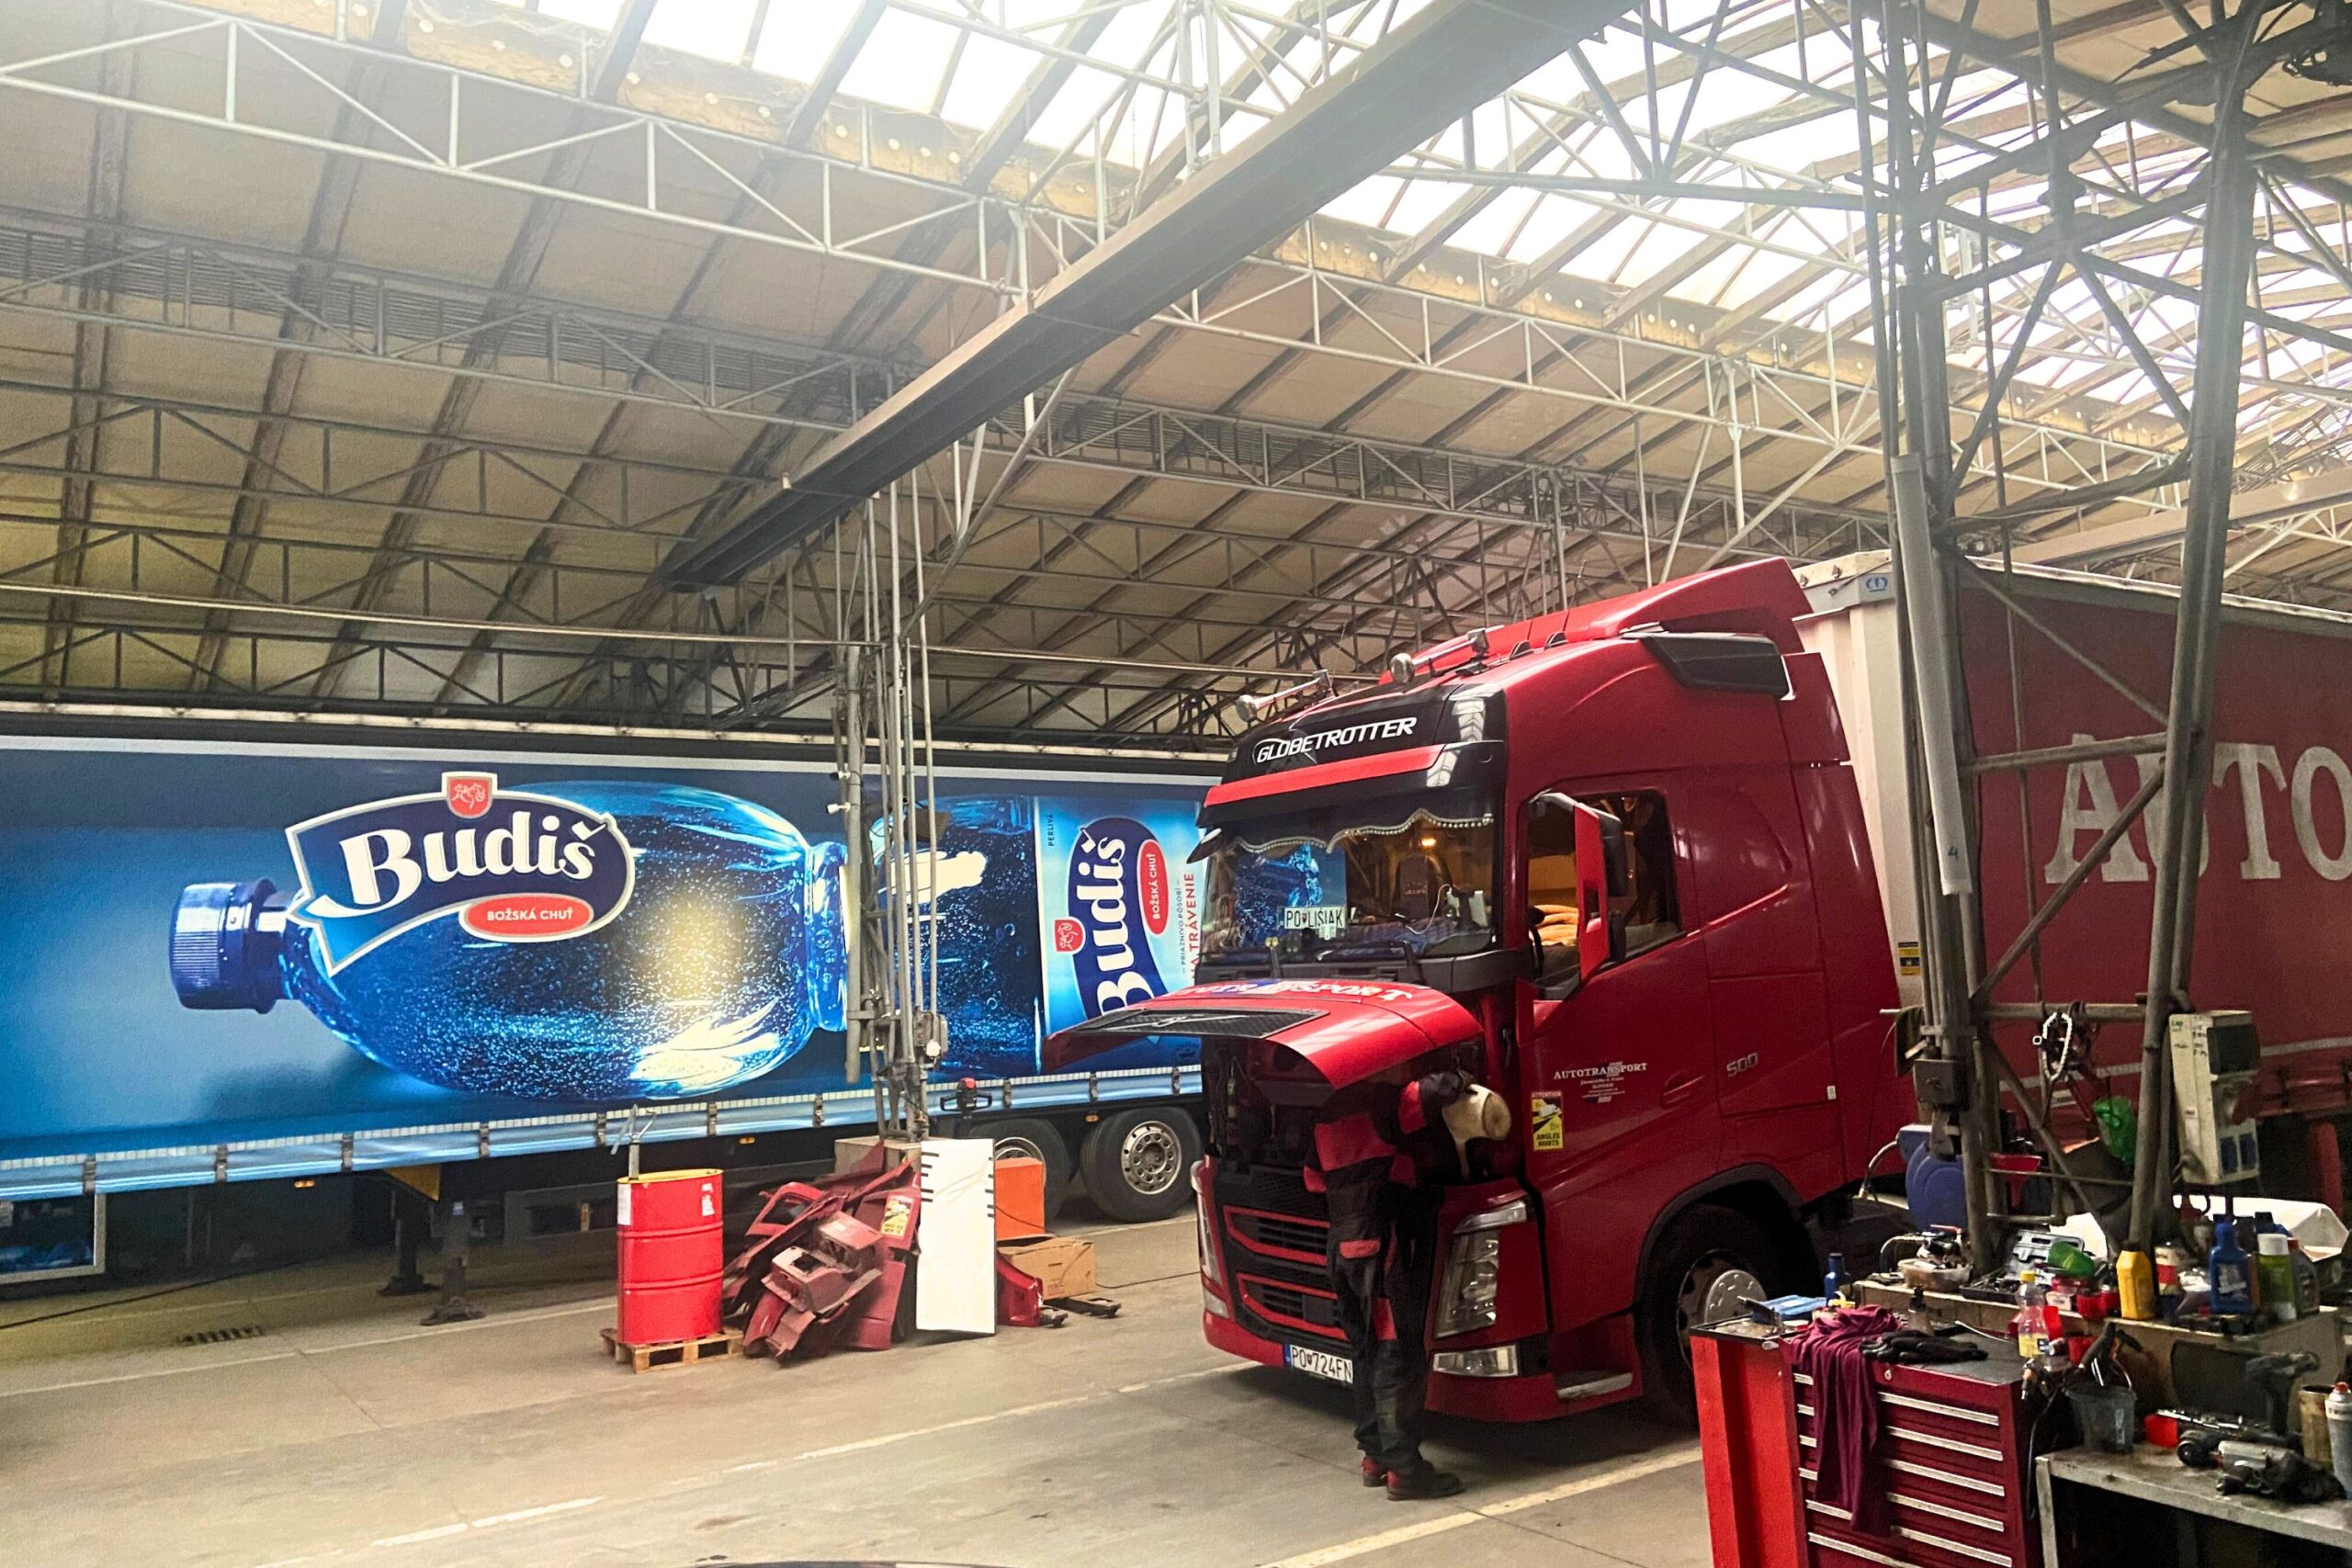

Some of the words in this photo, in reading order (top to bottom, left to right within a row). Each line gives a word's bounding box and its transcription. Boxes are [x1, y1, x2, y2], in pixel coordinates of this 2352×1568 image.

[1256, 716, 1417, 763] GLOBETROTTER
[306, 811, 606, 917] Budiš
[1146, 853, 1157, 878] CHUŤ
[487, 908, 537, 921] BOŽSKÁ
[539, 907, 573, 920] CHUŤ
[1148, 881, 1161, 919] BOŽSKÁ
[1184, 874, 1200, 952] TRÁVENIE
[1076, 829, 1155, 1015] Budiš
[1554, 1063, 1647, 1079] AUTOTRANSPORT
[1726, 1053, 1758, 1077] 500
[1292, 1347, 1306, 1368] PO
[1313, 1353, 1352, 1382] 724FN
